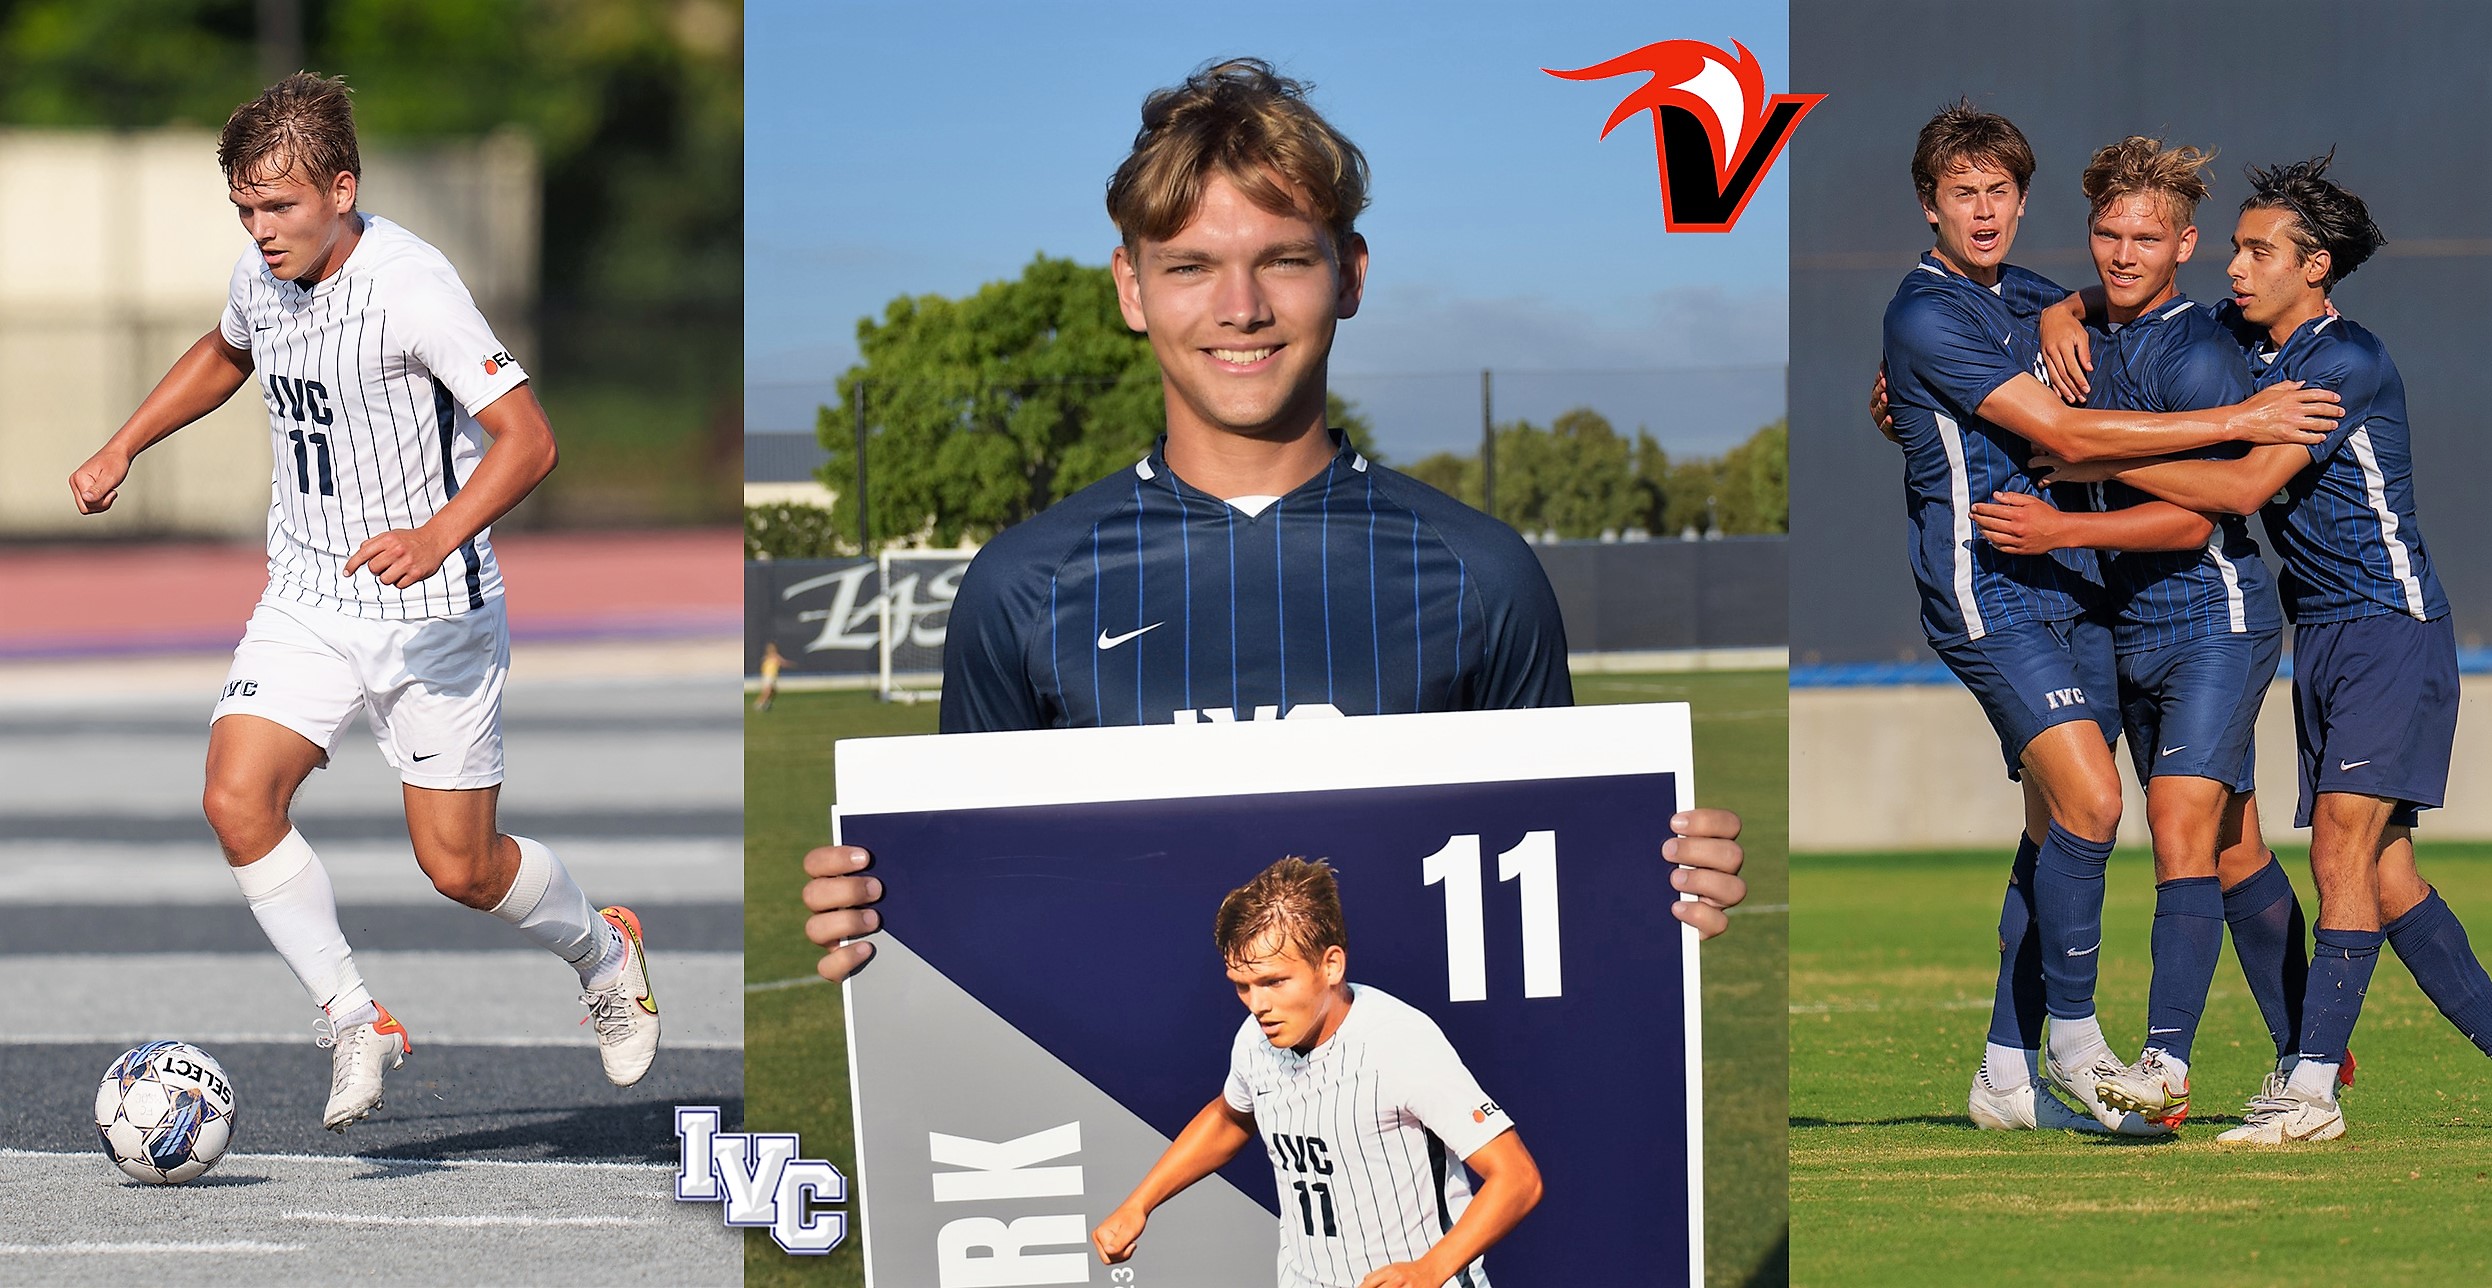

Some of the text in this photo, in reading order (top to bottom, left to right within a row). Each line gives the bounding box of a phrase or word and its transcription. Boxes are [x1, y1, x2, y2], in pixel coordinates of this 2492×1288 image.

[269, 374, 333, 426] IVC
[289, 429, 334, 496] 11
[220, 679, 258, 702] IVC
[2044, 687, 2086, 710] IVC
[1422, 830, 1562, 1002] 11
[162, 1057, 232, 1106] SELECT
[1272, 1133, 1334, 1176] IVC
[929, 1120, 1090, 1288] RK
[1293, 1181, 1337, 1237] 11
